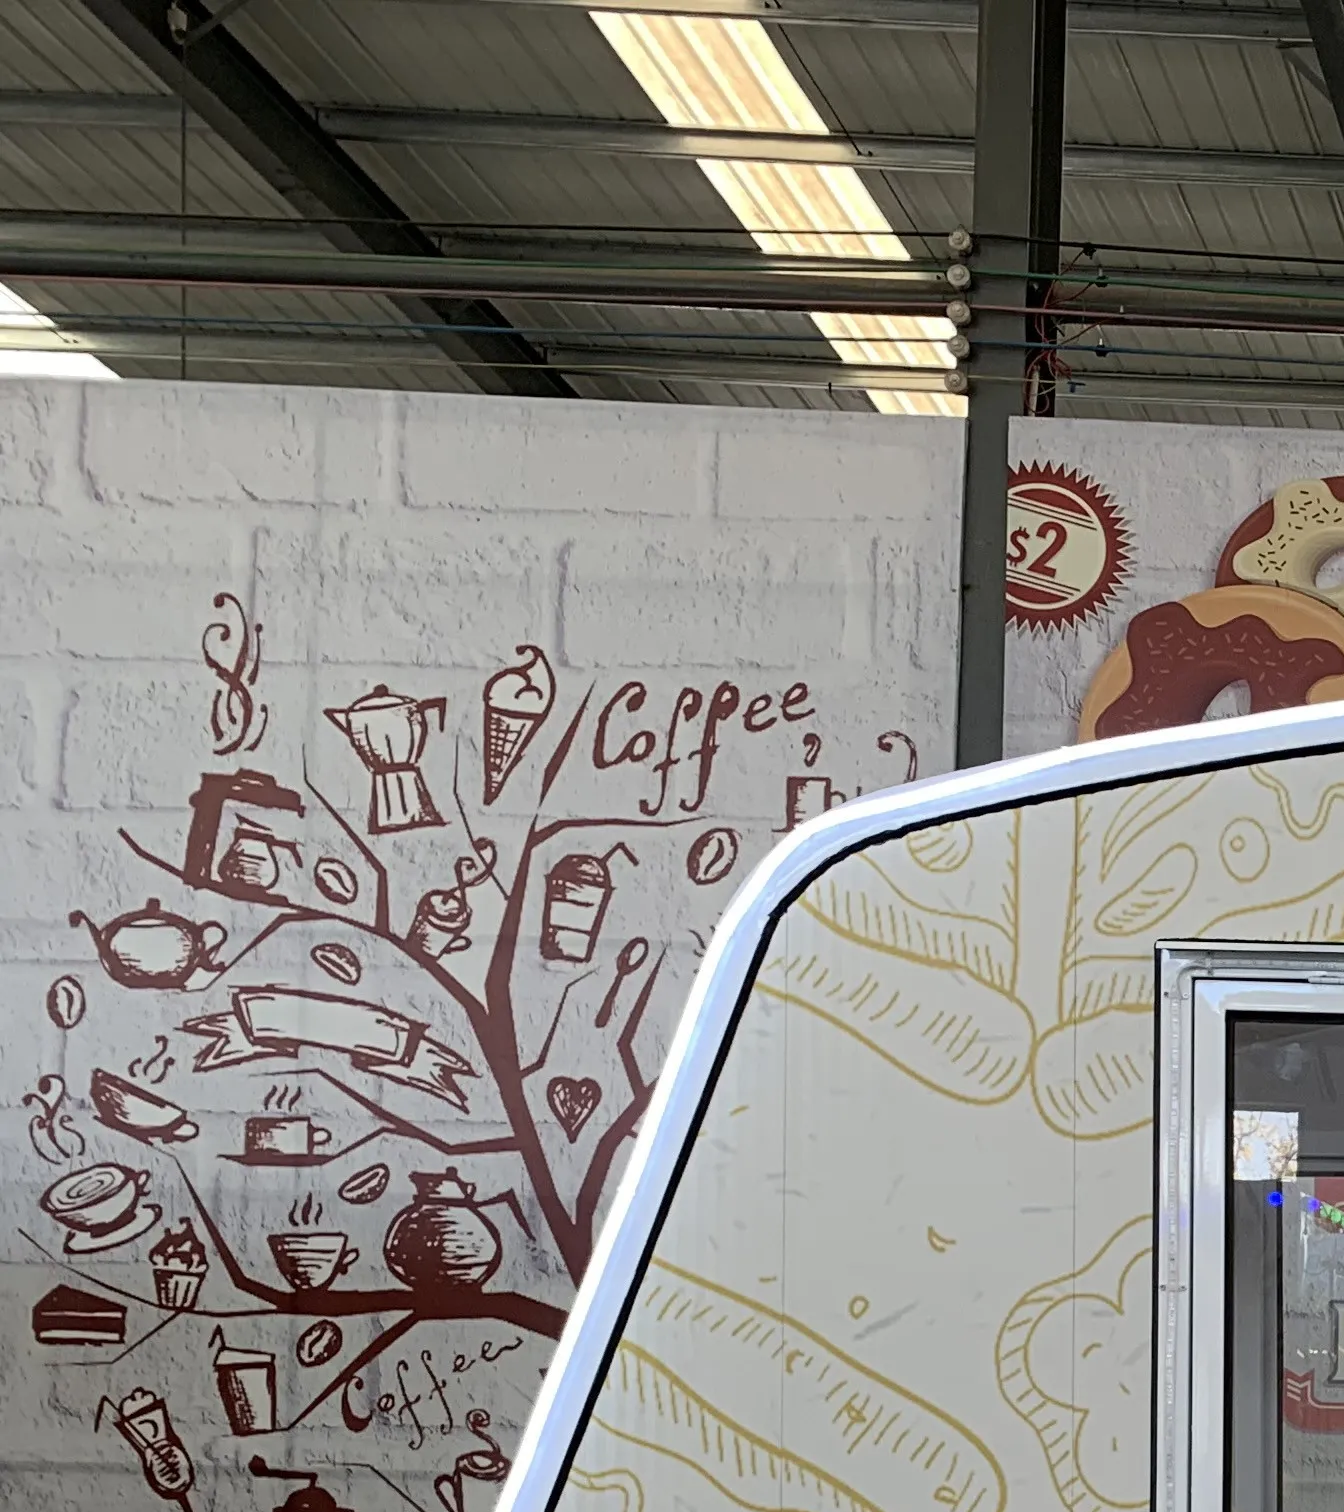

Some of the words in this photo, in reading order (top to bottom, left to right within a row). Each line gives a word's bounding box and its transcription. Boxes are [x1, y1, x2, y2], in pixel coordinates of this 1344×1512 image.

[1006, 521, 1067, 578] $2
[593, 680, 817, 817] Coffee
[340, 1335, 524, 1451] Coffee
